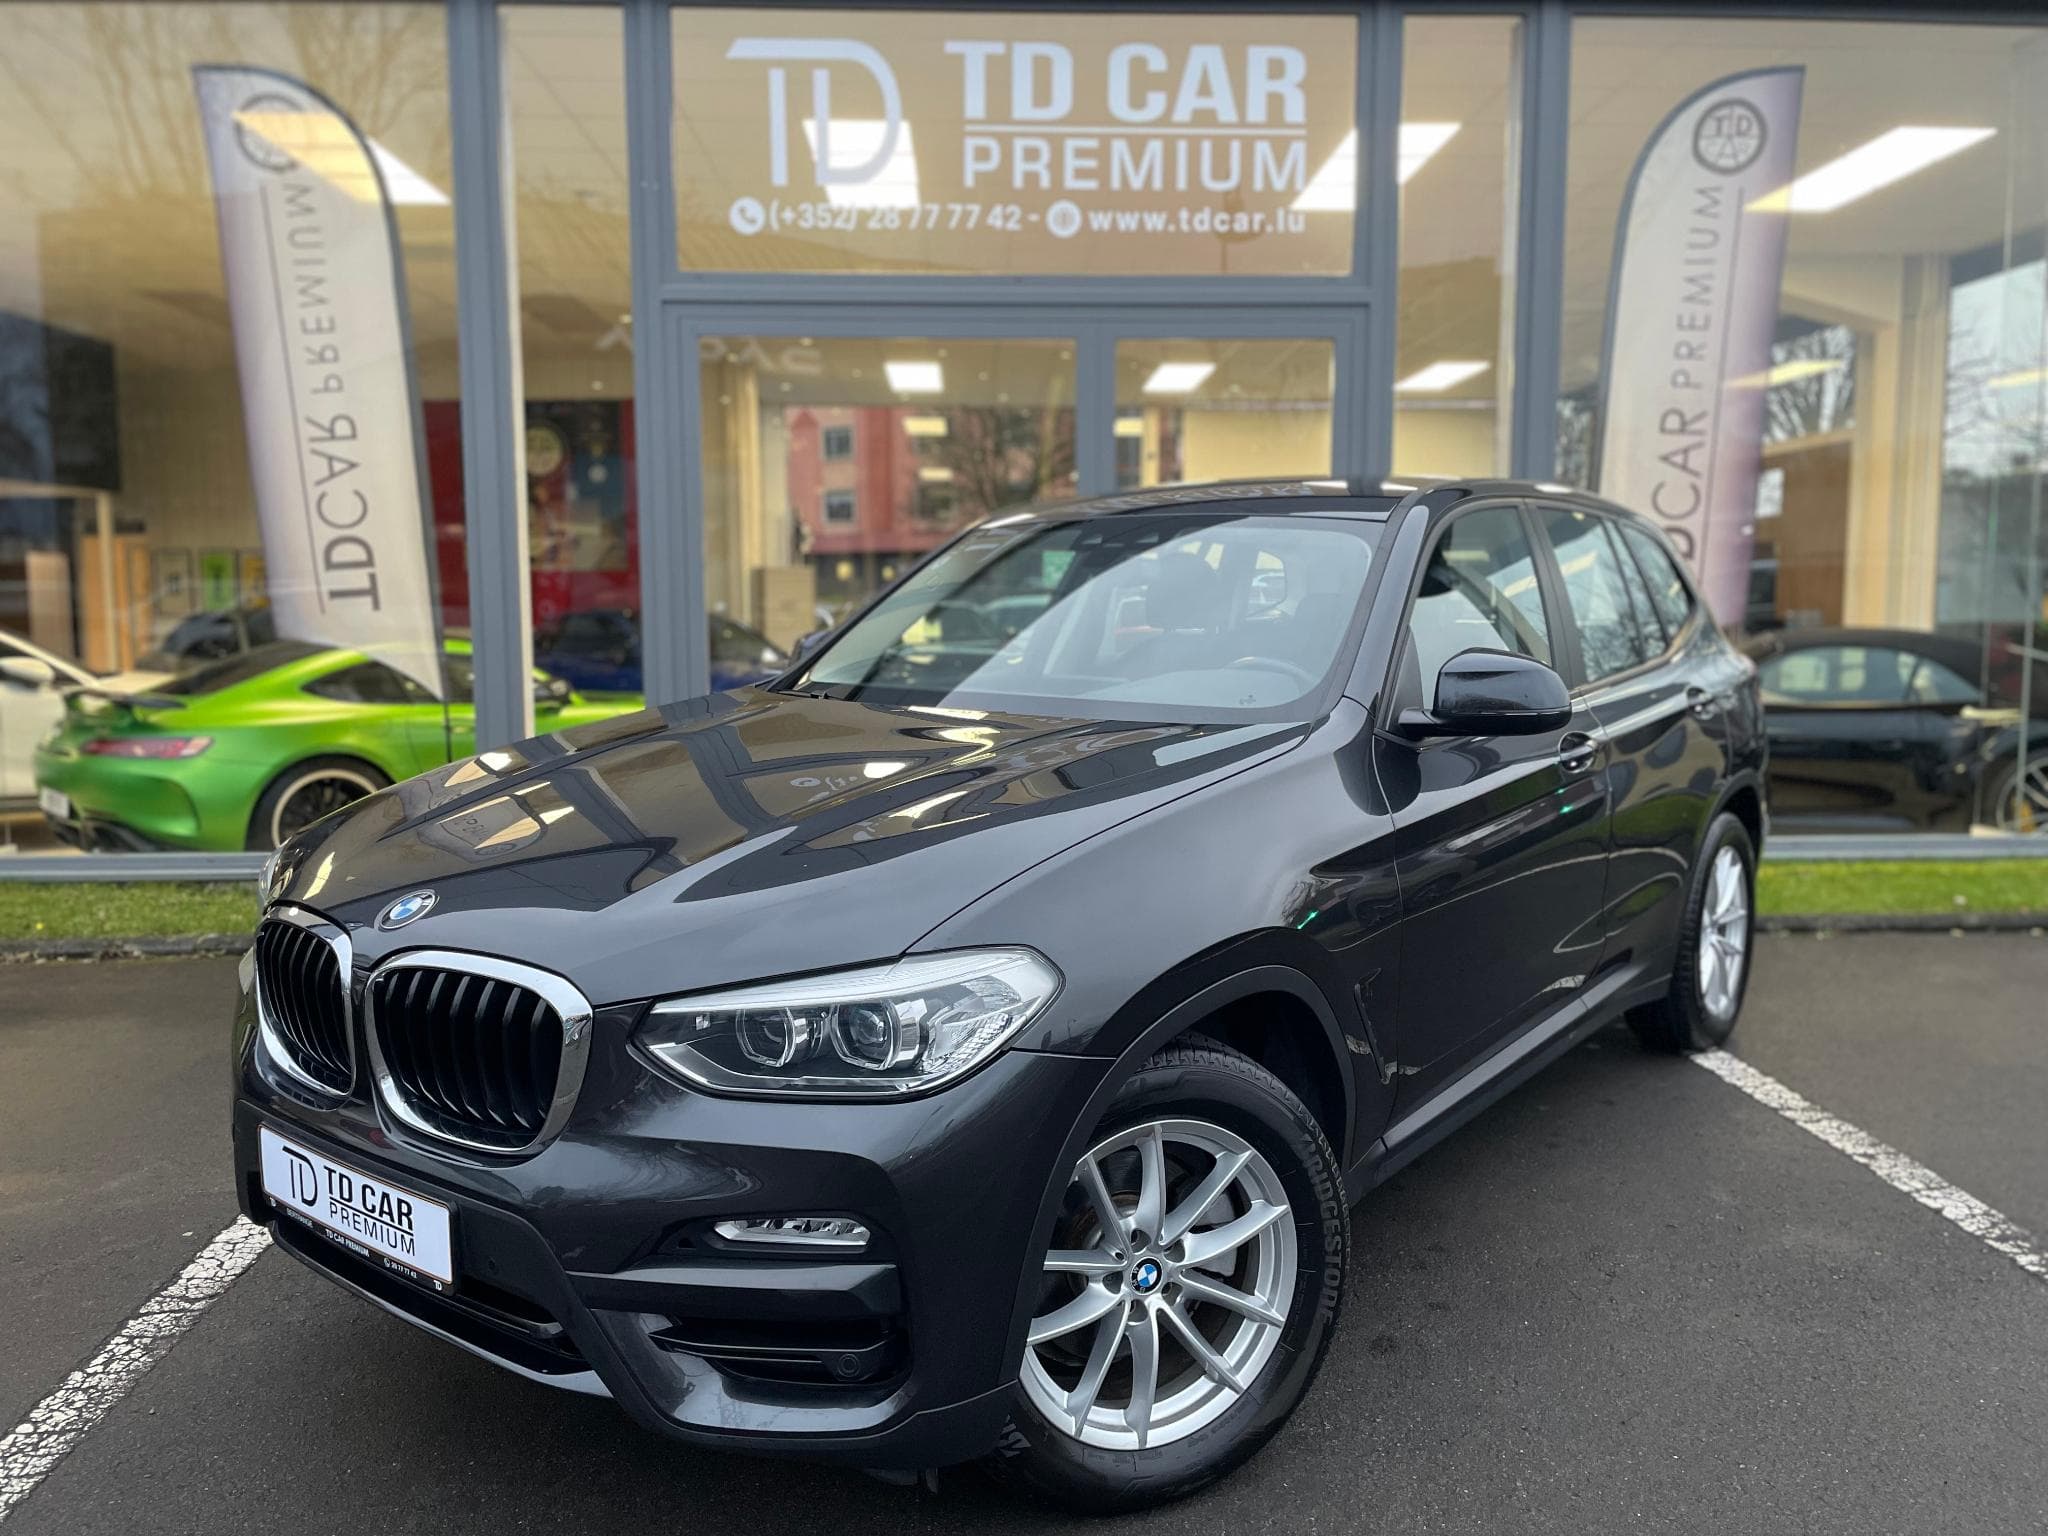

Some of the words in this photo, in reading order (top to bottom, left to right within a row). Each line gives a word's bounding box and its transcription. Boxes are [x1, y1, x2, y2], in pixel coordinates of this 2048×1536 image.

[726, 38, 902, 187] TD
[944, 41, 1073, 121] TD
[1107, 43, 1307, 124] CAR
[964, 137, 1307, 191] PREMIUM
[769, 199, 858, 233] (+352)
[867, 204, 901, 230] 28
[910, 204, 940, 230] 77
[947, 204, 981, 230] 77
[986, 204, 1021, 231] 42
[1088, 207, 1306, 234] www.tdcar.lu
[1670, 186, 1723, 390] PREMIUM
[1651, 407, 1709, 560] DCAR
[282, 1145, 317, 1207] TD
[323, 1165, 353, 1203] TD
[361, 1184, 413, 1231] CAR
[330, 1202, 416, 1256] PREMIUM
[433, 1279, 443, 1291] TD
